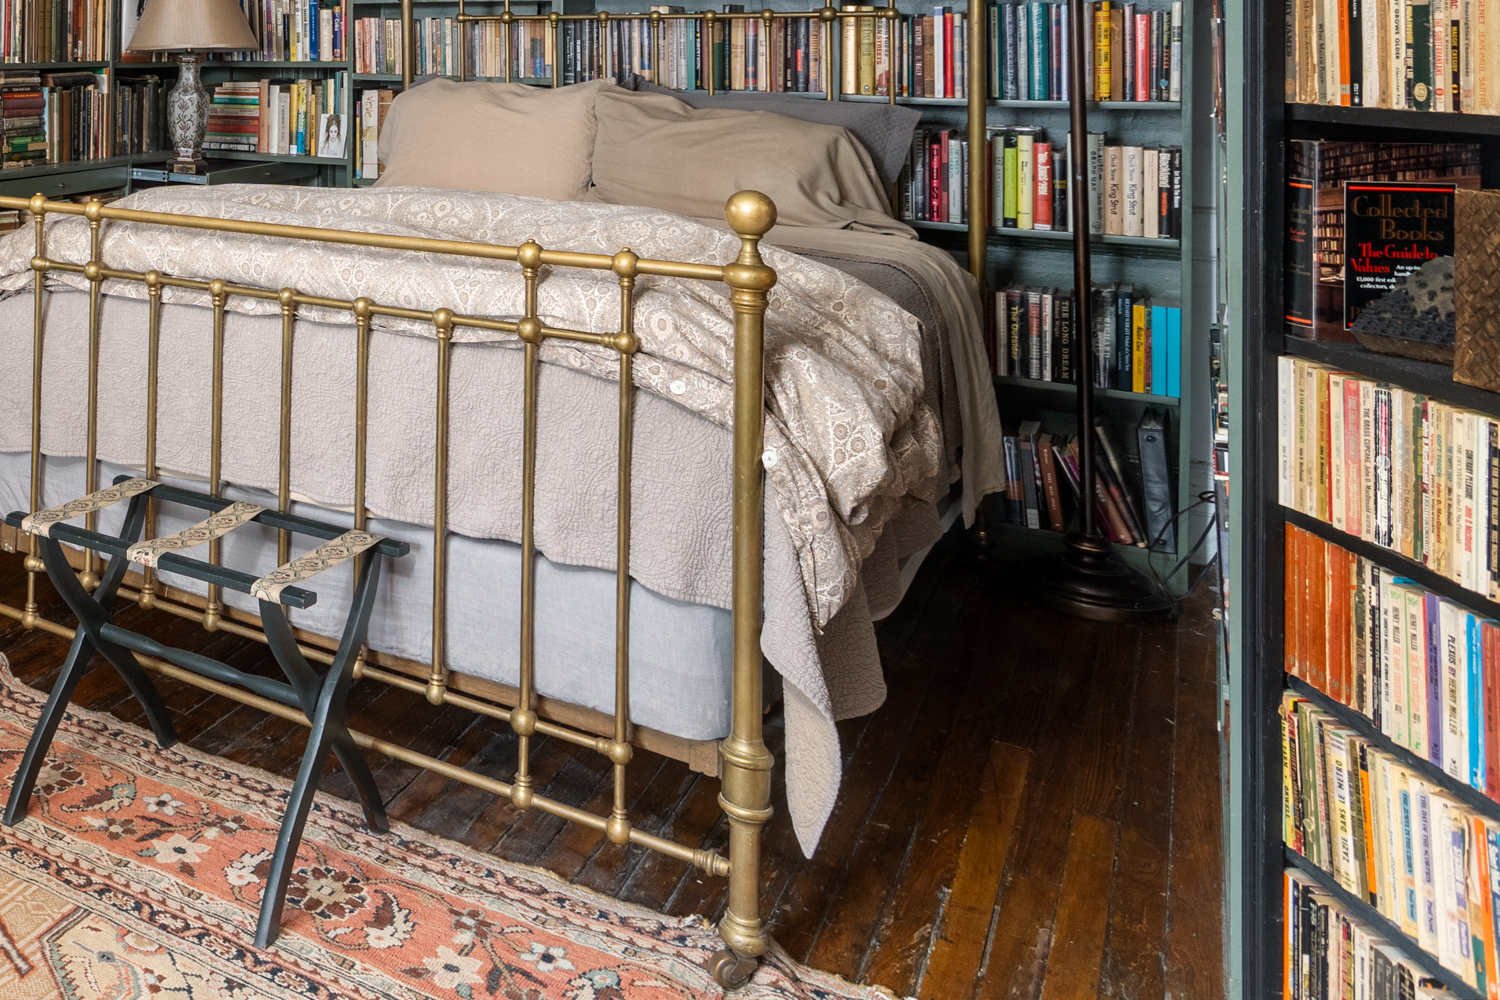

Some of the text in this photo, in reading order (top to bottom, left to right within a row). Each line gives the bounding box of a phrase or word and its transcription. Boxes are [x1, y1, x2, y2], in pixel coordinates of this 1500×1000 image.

[1159, 152, 1170, 188] Blackland
[1109, 183, 1118, 198] King
[1128, 183, 1137, 198] King
[1110, 199, 1118, 216] Strut
[1128, 200, 1137, 216] Strut
[1351, 194, 1448, 218] Collected
[1380, 218, 1444, 240] Books
[1358, 242, 1438, 260] The Guide to
[1350, 258, 1390, 273] Values
[1448, 634, 1456, 665] PLEXUS
[1448, 666, 1456, 677] BY
